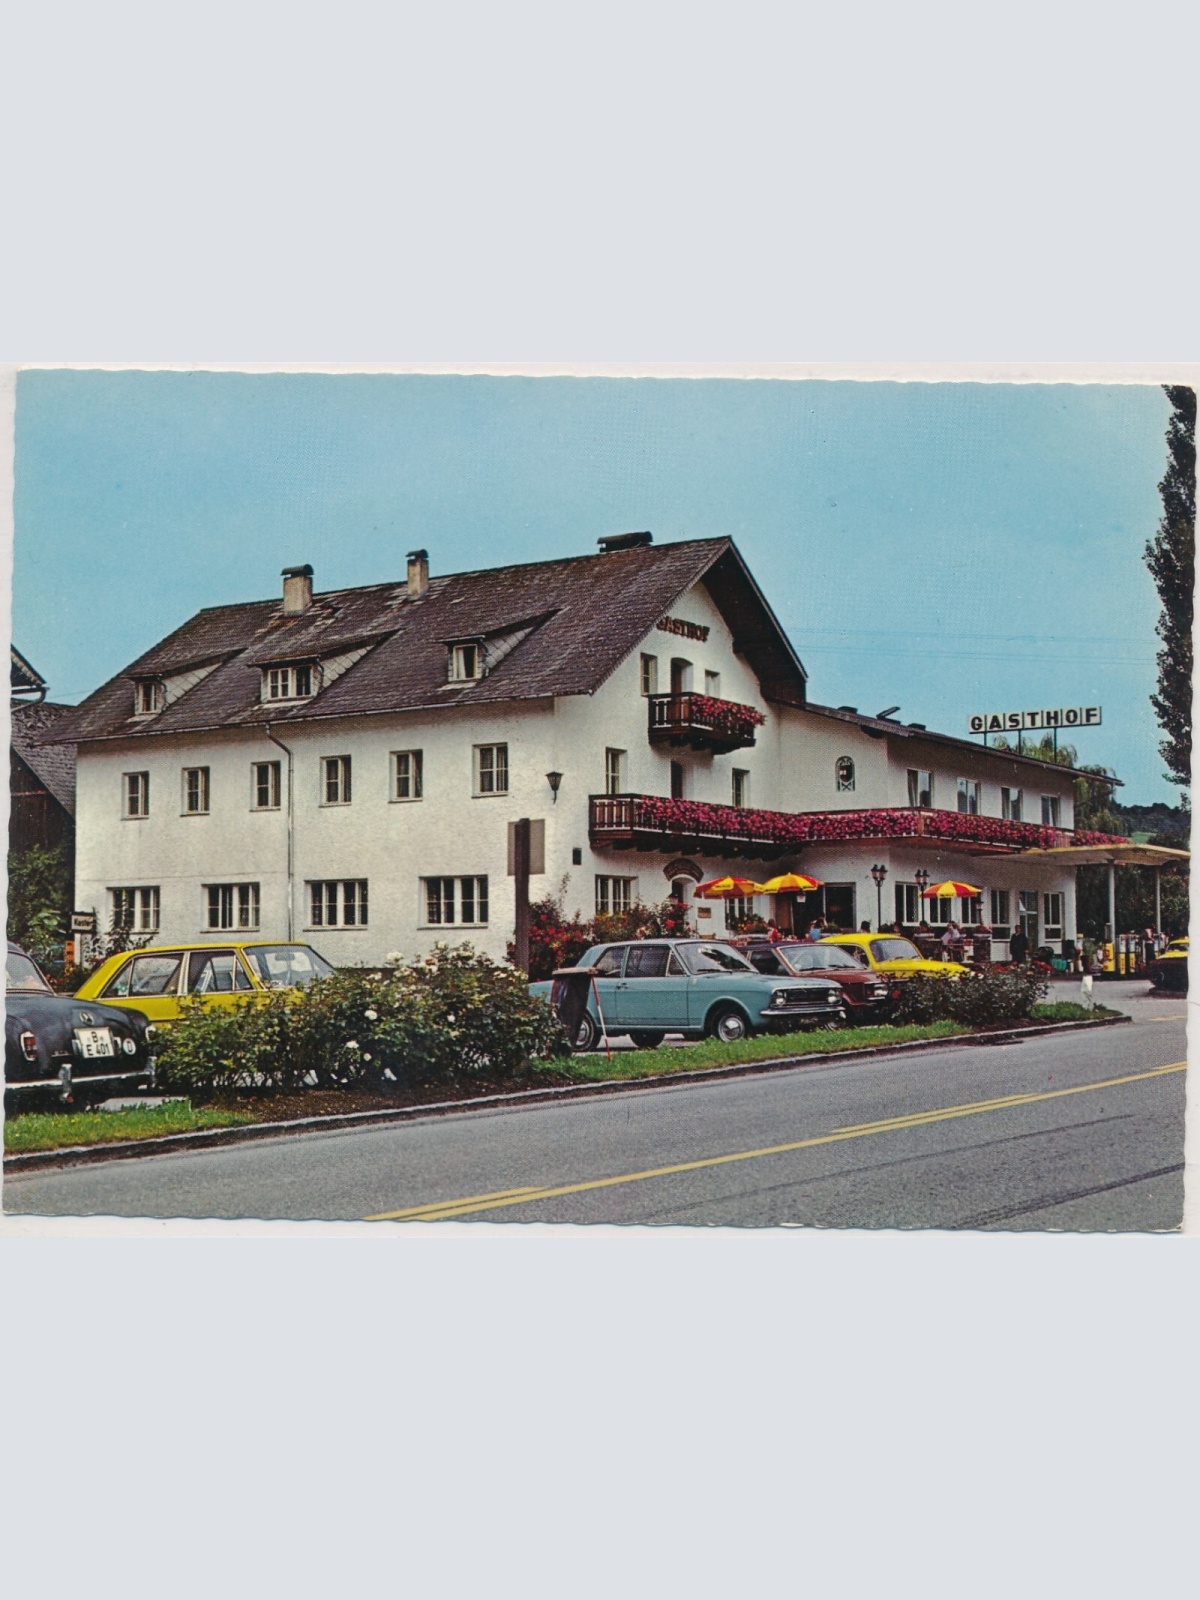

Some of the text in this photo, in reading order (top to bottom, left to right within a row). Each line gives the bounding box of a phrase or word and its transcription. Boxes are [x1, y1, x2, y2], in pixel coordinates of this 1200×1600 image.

[970, 707, 1098, 731] GASTHOF
[91, 1031, 99, 1043] B
[86, 1044, 94, 1056] E
[96, 1043, 111, 1056] 401
[126, 1040, 134, 1053] D
